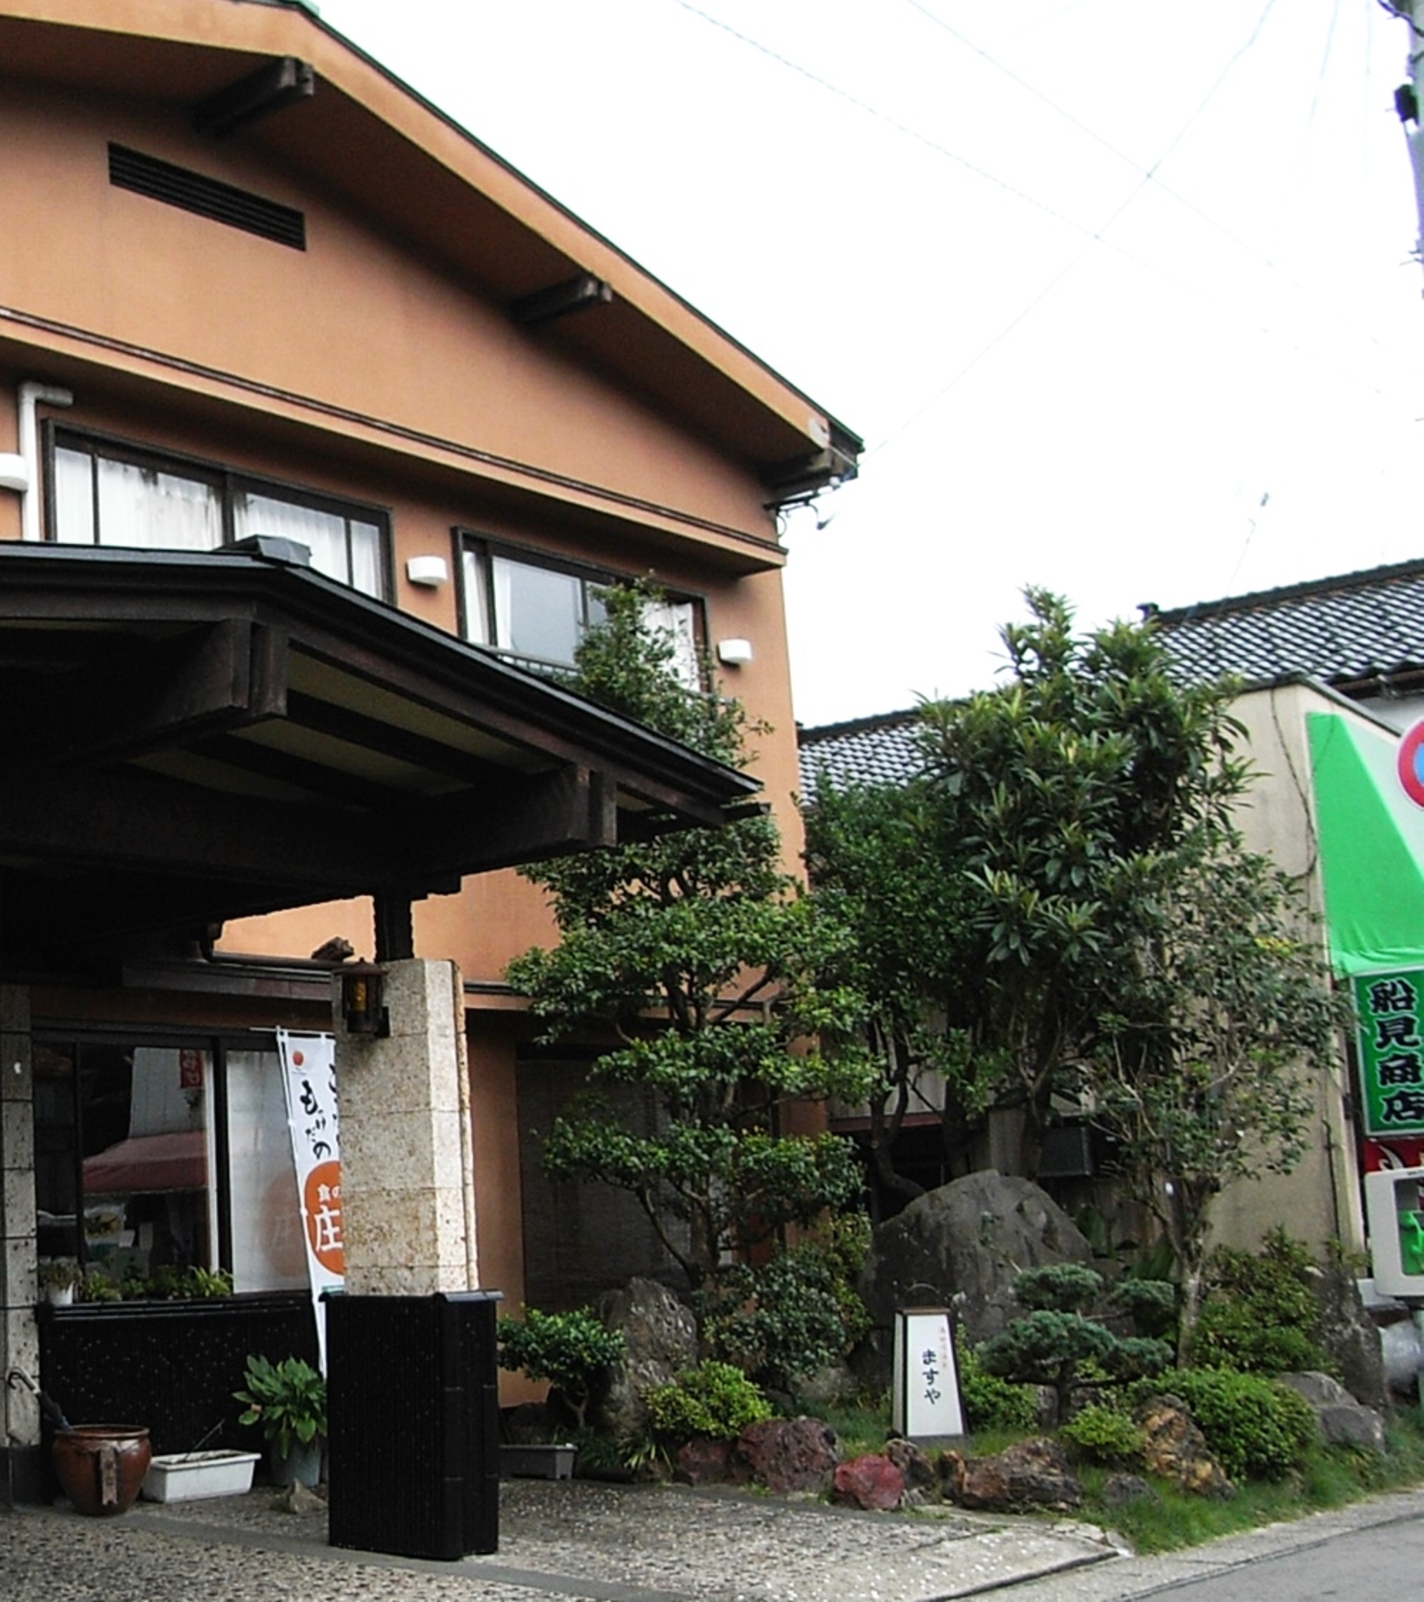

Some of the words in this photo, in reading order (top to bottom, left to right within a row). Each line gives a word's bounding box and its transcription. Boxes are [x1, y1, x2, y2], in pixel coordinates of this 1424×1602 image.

[1366, 978, 1424, 1123] 船見商店
[922, 1349, 940, 1404] ますや
